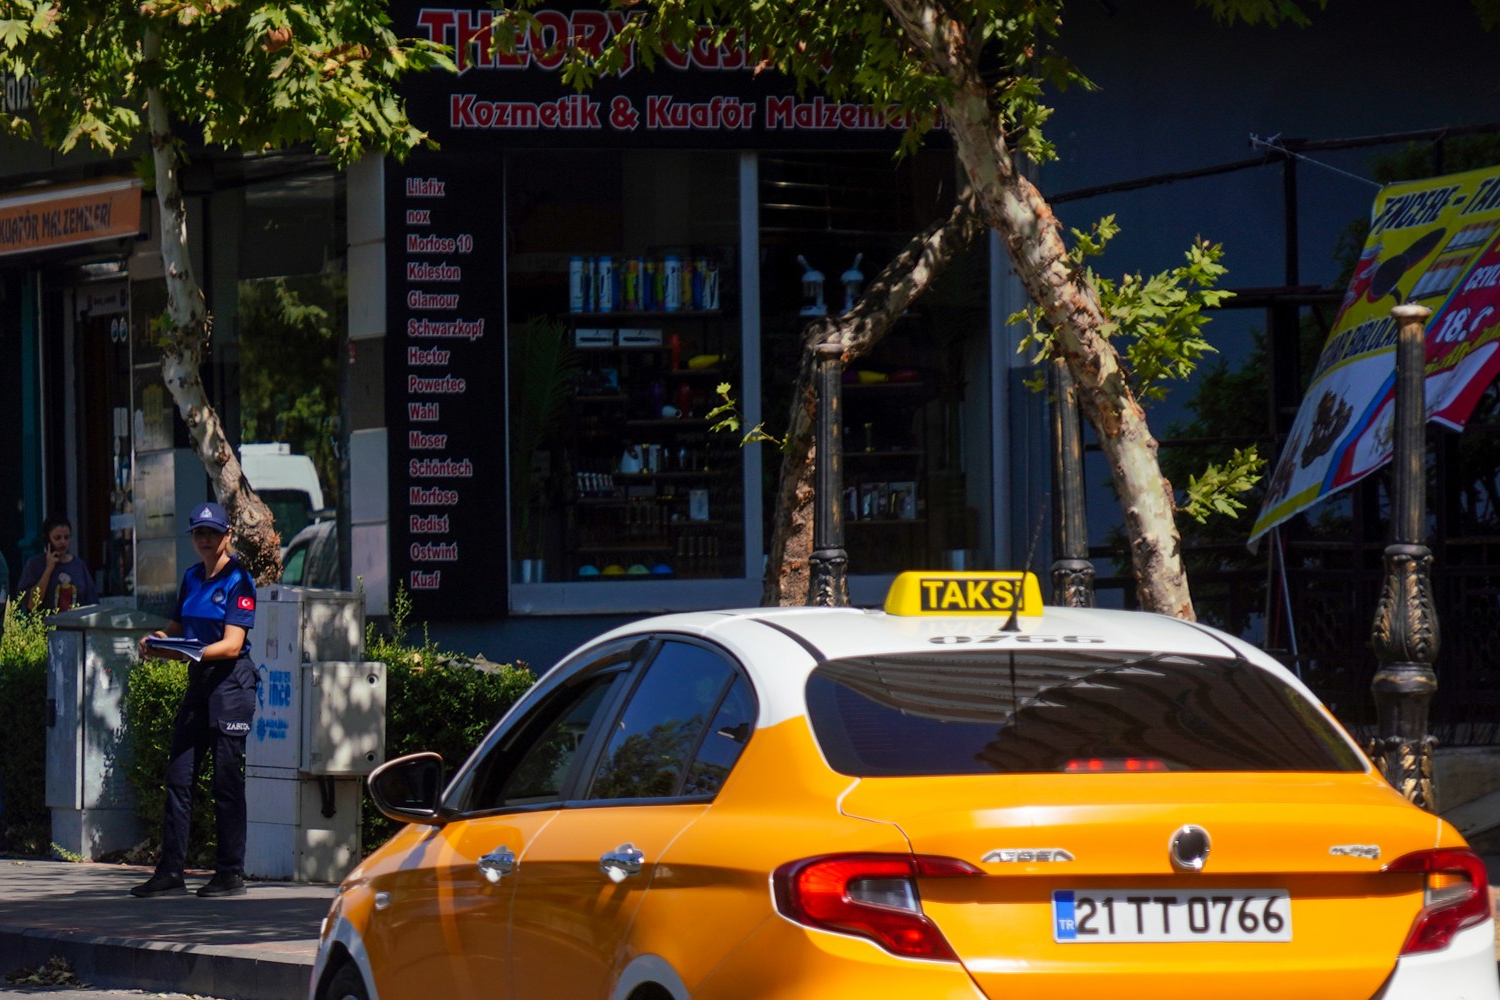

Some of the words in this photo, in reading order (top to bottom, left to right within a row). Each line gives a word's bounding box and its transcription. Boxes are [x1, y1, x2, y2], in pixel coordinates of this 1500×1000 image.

[417, 8, 646, 78] THEORY
[450, 93, 600, 129] Kozmetik
[610, 95, 639, 130] &
[646, 95, 756, 129] Kuaför
[406, 177, 446, 197] Lilafix
[406, 209, 431, 225] nox
[406, 233, 456, 253] Morfose
[457, 233, 474, 253] 10
[406, 261, 462, 281] Koleston
[407, 290, 460, 310] Glamour
[407, 317, 485, 342] Schwarzkopf
[408, 345, 451, 366] Hector
[408, 373, 467, 394] Powertec
[408, 402, 440, 421] Wahl
[409, 430, 448, 449] Moser
[409, 457, 473, 478] Schöntech
[409, 486, 459, 506] Morfose
[409, 514, 450, 534] Redist
[409, 541, 459, 561] Ostwint
[410, 569, 441, 590] Kuaf
[1059, 918, 1077, 931] TR
[1075, 896, 1116, 935] 21
[1126, 895, 1179, 935] TT
[1187, 895, 1286, 935] 0766
